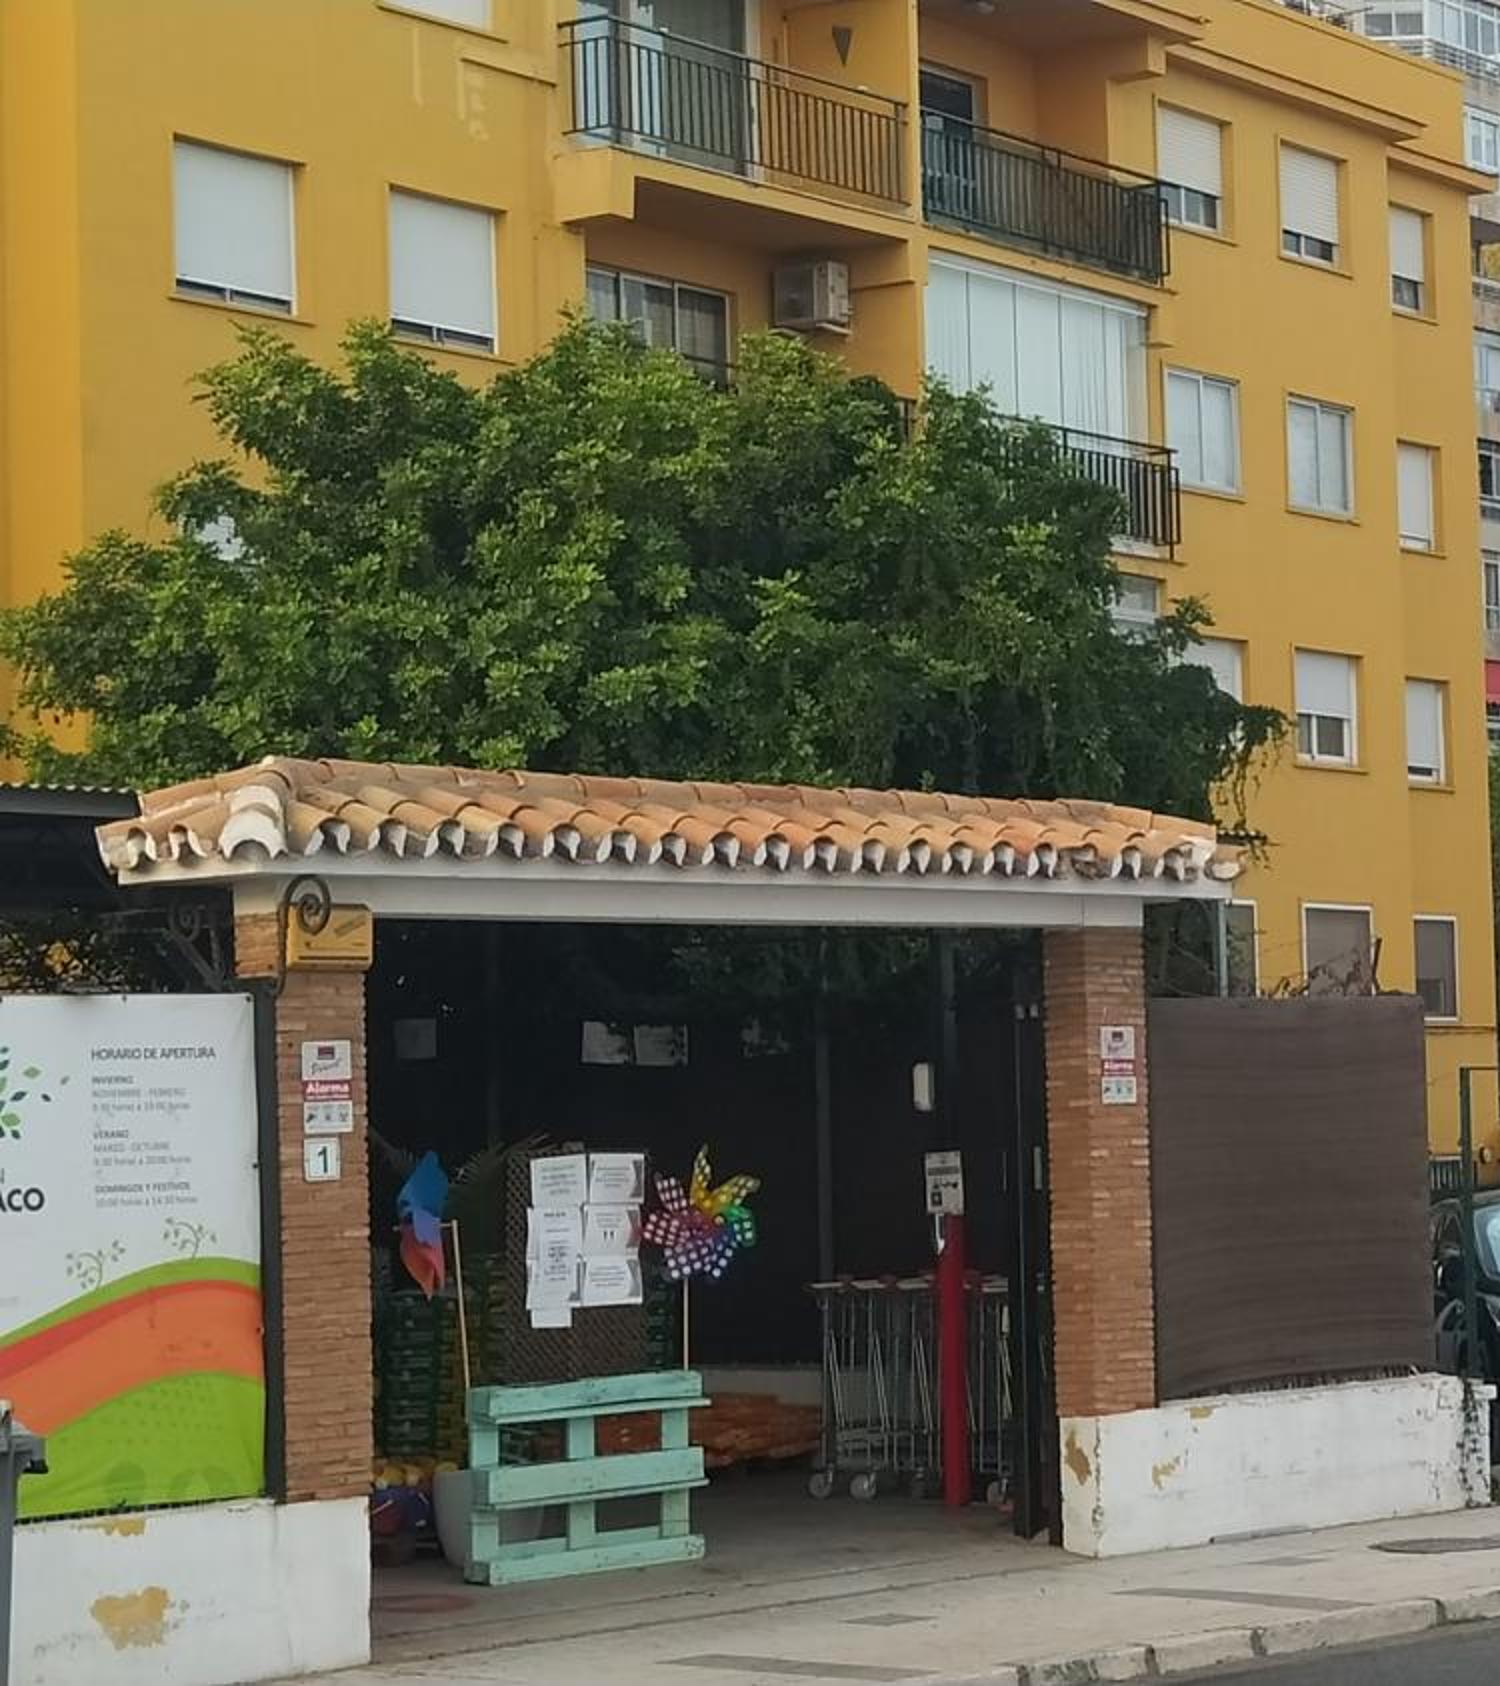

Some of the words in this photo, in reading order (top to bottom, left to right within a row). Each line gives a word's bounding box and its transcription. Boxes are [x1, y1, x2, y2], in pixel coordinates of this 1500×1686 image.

[91, 1047, 141, 1060] HORARIO
[143, 1047, 158, 1059] DE
[160, 1046, 216, 1059] APERTURA
[306, 1081, 349, 1093] Alarma
[317, 1145, 328, 1174] 1
